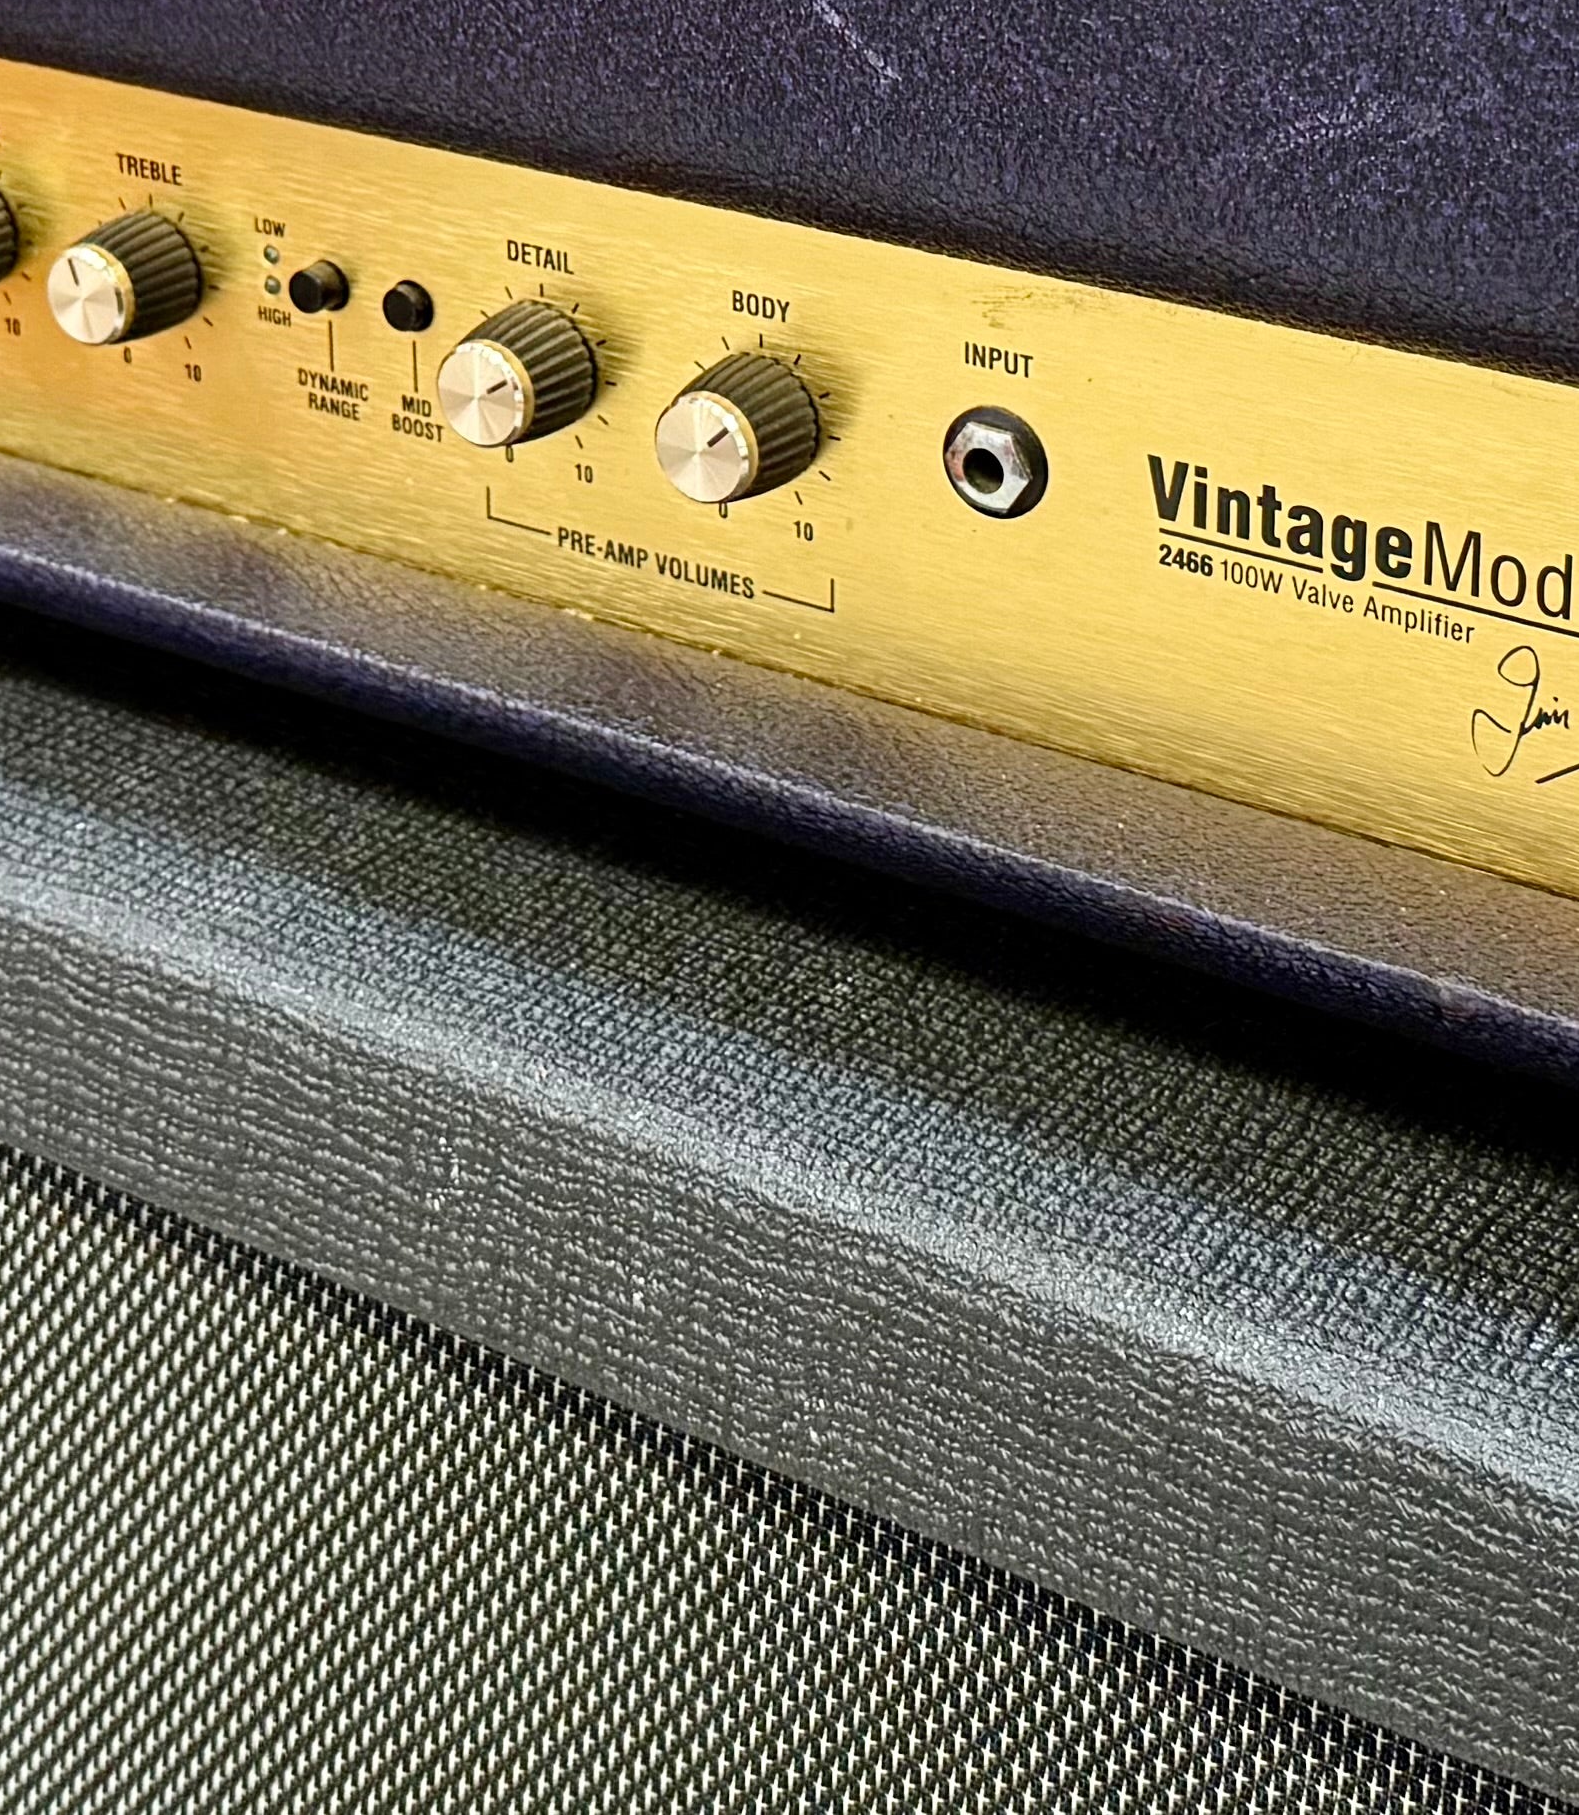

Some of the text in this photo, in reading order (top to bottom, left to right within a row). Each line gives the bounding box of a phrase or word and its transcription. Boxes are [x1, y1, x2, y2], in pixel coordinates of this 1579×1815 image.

[116, 152, 183, 186] TREBLE
[254, 216, 286, 237] LOW
[506, 239, 574, 275] DETAIL
[257, 305, 292, 327] HIGH
[731, 289, 790, 324] BODY
[5, 317, 22, 336] 10
[123, 346, 202, 383] 0 10
[963, 341, 1034, 379] INPUT
[297, 367, 370, 403] DYNAMIC
[308, 392, 361, 422] RANGE
[401, 394, 432, 418] MID
[391, 413, 445, 444] BOOST
[505, 444, 594, 484] 0 10
[718, 501, 814, 542] 0 10
[558, 526, 756, 600] PRE-AMP VOLUMES
[1158, 542, 1476, 644] 2466 100W Valve Amplifier
[1471, 645, 1569, 778] Jim
